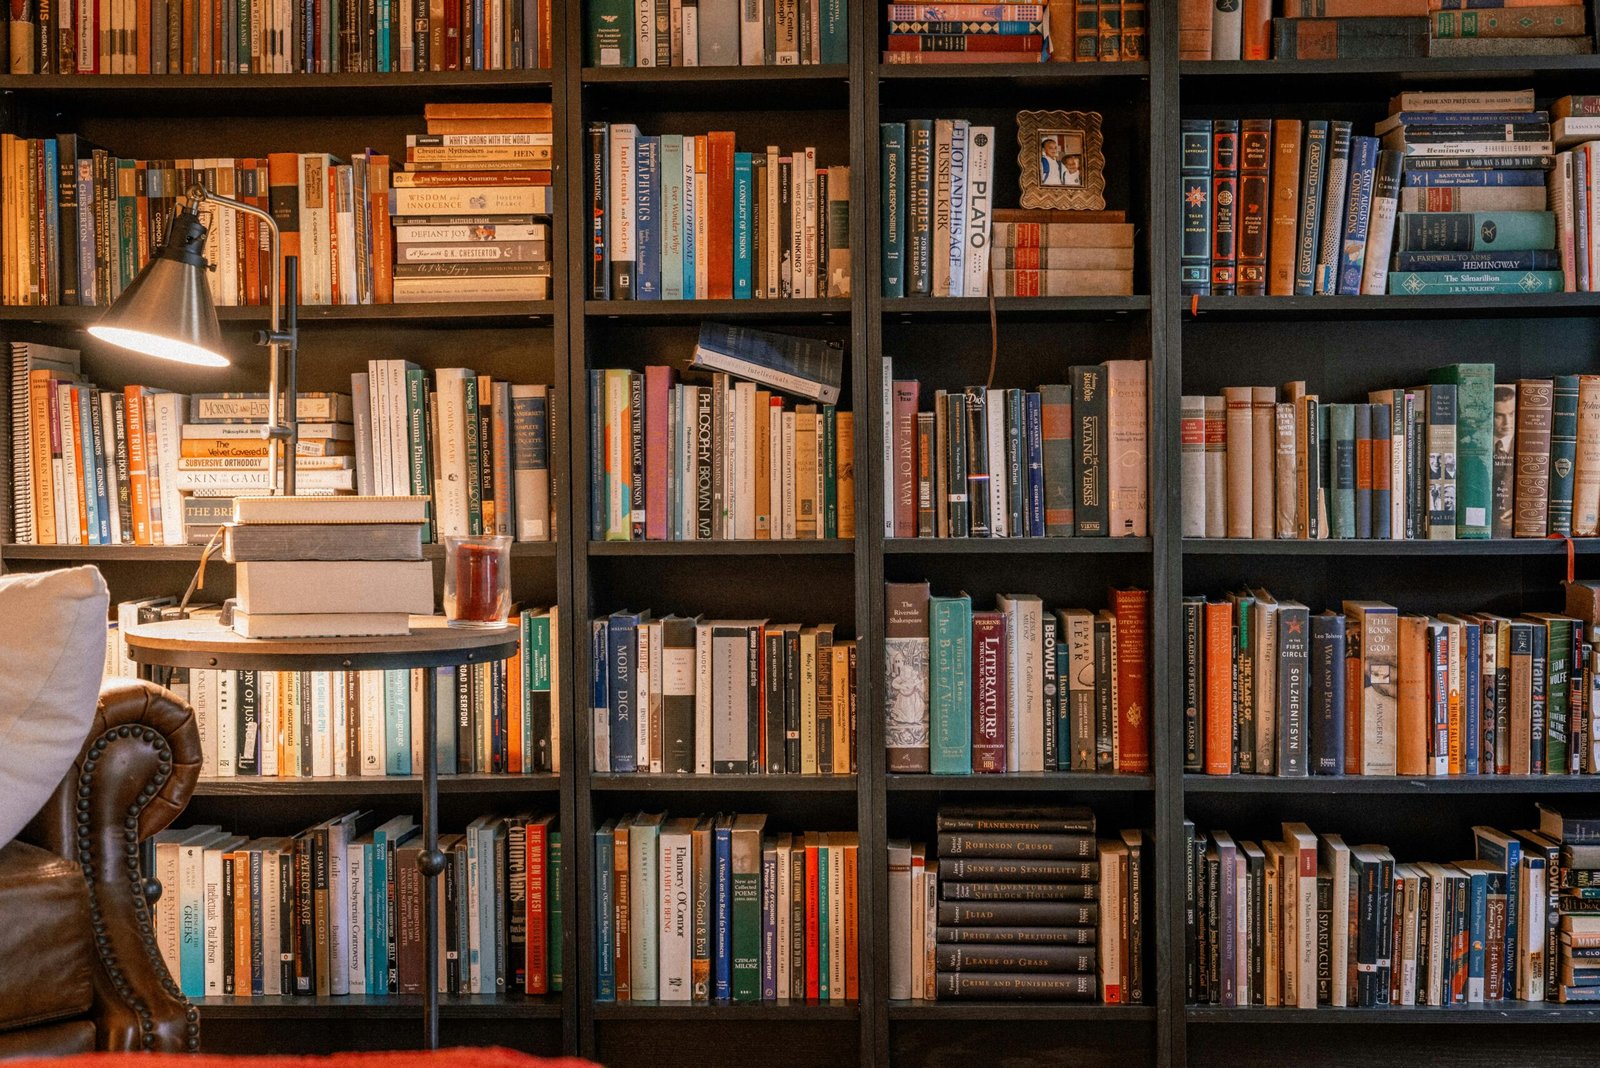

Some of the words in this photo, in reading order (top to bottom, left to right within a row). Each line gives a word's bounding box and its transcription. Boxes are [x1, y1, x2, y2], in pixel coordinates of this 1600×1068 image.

[640, 9, 649, 42] LOGIC
[449, 135, 467, 144] WHAT'S
[469, 135, 487, 144] WRONG
[489, 135, 500, 144] WITH
[502, 135, 512, 144] THE
[514, 134, 530, 144] WORLD
[951, 128, 964, 171] ELIOT
[917, 130, 928, 182] BEYOND
[938, 143, 949, 196] RUSSELL
[1308, 145, 1319, 186] AROUND
[594, 153, 603, 200] DISMANTLING
[621, 146, 629, 205] Intellectuals
[639, 143, 650, 221] METAPHYSICS
[1363, 169, 1371, 191] SAINT
[950, 173, 963, 208] AND
[1347, 173, 1360, 234] CONFESSIONS
[917, 188, 928, 231] ORDER
[937, 200, 948, 230] KIRK
[949, 210, 961, 234] HIS
[971, 181, 986, 248] PLATO
[1305, 195, 1315, 230] WORLD
[1357, 194, 1369, 238] AUGUSTINE
[452, 230, 467, 238] JOY
[594, 208, 604, 261] America
[619, 222, 629, 254] Society
[739, 221, 746, 231] OF
[460, 247, 497, 257] CHESTERTON
[949, 235, 961, 266] AGE
[1304, 237, 1312, 248] 80
[1301, 250, 1311, 273] DAYS
[1463, 260, 1520, 270] HEMINGWAY
[1461, 274, 1499, 282] Silmarillion
[747, 367, 789, 384] Intellectuals
[632, 380, 641, 408] REASON
[129, 397, 138, 429] SAVING
[204, 402, 238, 416] MORNING
[633, 410, 641, 418] IN
[116, 410, 124, 439] UNIVERSE
[413, 408, 422, 442] Summa
[633, 420, 641, 433] THE
[699, 394, 710, 461] PHILOSOPHY
[900, 414, 911, 436] THE
[38, 424, 48, 474] UNBROKEN
[118, 441, 126, 458] NEXT
[131, 433, 140, 461] TRUTH
[633, 435, 642, 465] BALANCE
[900, 440, 911, 459] ART
[1083, 417, 1093, 464] SATANIC
[119, 460, 128, 480] DOOR
[185, 459, 222, 467] SUBVERSIVE
[225, 459, 262, 467] ORTHODOXY
[901, 462, 911, 477] OF
[187, 474, 217, 484] SKIN
[484, 476, 492, 488] Evil
[633, 473, 642, 505] JOHNSON
[699, 466, 710, 510] BROWN
[900, 481, 911, 505] WAR
[1084, 469, 1093, 505] VERSES
[41, 479, 50, 515] THREAD
[187, 507, 210, 517] THE
[699, 519, 710, 536] IVP
[939, 607, 950, 634] The
[1045, 625, 1055, 680] BEOWULF
[1075, 621, 1083, 661] LEAR
[1325, 645, 1333, 665] WAR
[618, 645, 628, 681] MOBY
[939, 640, 950, 672] Book
[461, 684, 468, 692] TO
[938, 677, 950, 689] of
[985, 637, 999, 739] LITERATURE
[1026, 665, 1034, 693] Collected
[1533, 658, 1545, 692] franz
[461, 694, 469, 727] SERFDOM
[618, 690, 628, 721] DICK
[940, 692, 951, 741] Virtues
[1290, 668, 1299, 749] SOLZHENITSYN
[1498, 674, 1507, 733] SILENCE
[1533, 700, 1544, 740] kafka
[531, 831, 541, 842] THE
[977, 821, 1040, 830] FRANKENSTEIN
[509, 827, 525, 872] Culture
[531, 846, 541, 862] WAR
[965, 841, 1012, 850] ROBINSON
[1017, 842, 1054, 851] CRUSOE
[301, 854, 310, 894] PATRIOT
[331, 856, 341, 877] fault
[532, 865, 541, 875] ON
[664, 867, 672, 892] HABIT
[675, 847, 687, 888] Flannery
[719, 864, 727, 882] Wreck
[967, 865, 993, 873] SENSE
[1020, 865, 1077, 874] SENSIBILITY
[1550, 852, 1559, 908] BEOWULF
[509, 873, 525, 901] Wars
[531, 877, 541, 890] THE
[207, 883, 218, 920] Intellectuals
[302, 899, 311, 925] SAGE
[350, 878, 360, 923] Presbyterian
[531, 892, 541, 912] WEST
[664, 895, 672, 906] OF
[676, 892, 687, 937] O'Connor
[695, 900, 705, 924] Good
[719, 904, 727, 919] Road
[184, 905, 192, 943] GREEKS
[664, 908, 672, 933] BEING
[965, 911, 993, 919] ILIAD
[207, 926, 216, 940] Paul
[351, 924, 360, 970] Controversy
[696, 938, 705, 956] Evil
[719, 927, 727, 958] Damascus
[962, 932, 990, 940] PRIDE
[1018, 932, 1067, 941] PREJUDICE
[1319, 914, 1329, 976] SPARTACUS
[207, 941, 217, 963] Johnson
[766, 932, 774, 980] Baumgaertner
[965, 958, 998, 966] LEAVES
[1018, 958, 1048, 966] GRASS
[1304, 949, 1312, 963] King
[961, 979, 989, 987] CRIME
[1490, 963, 1498, 989] WHITE
